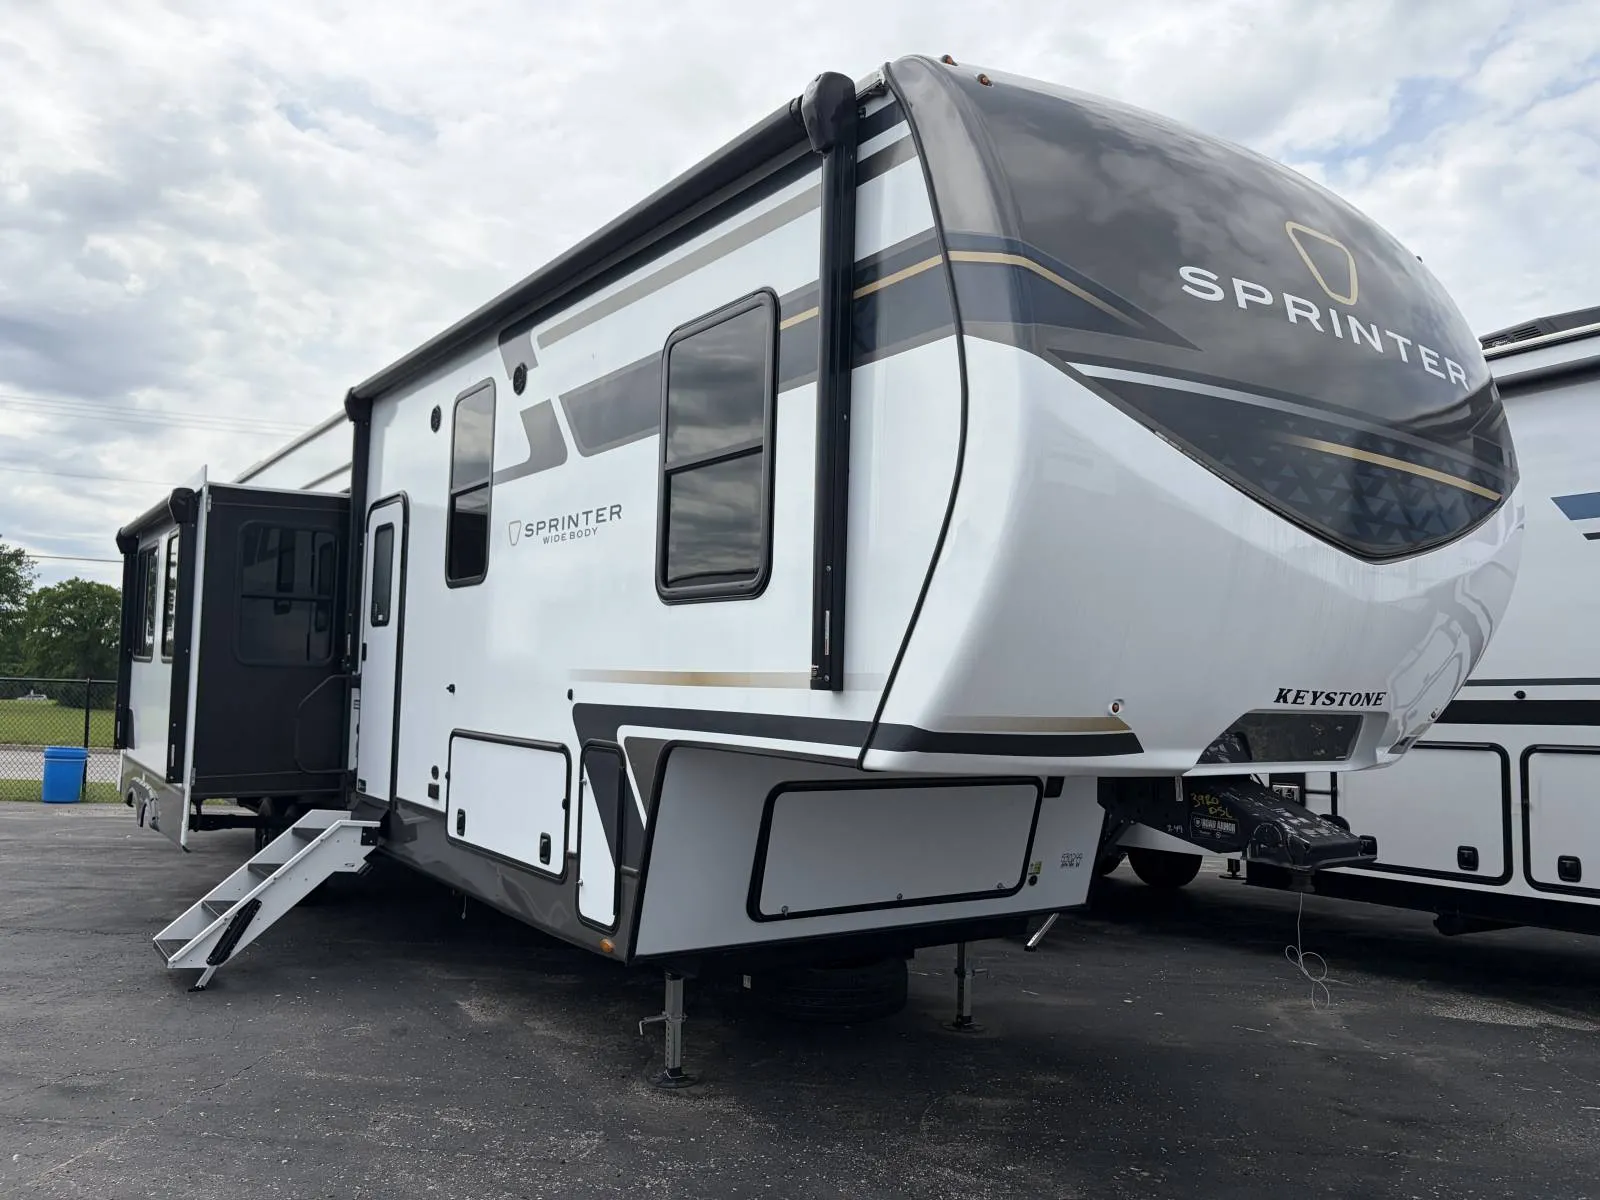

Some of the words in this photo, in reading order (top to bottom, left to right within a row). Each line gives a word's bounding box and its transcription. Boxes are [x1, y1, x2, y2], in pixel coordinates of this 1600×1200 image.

[1179, 265, 1470, 391] SPRINTER
[524, 504, 622, 538] SPRINTER
[543, 533, 567, 545] WIDE
[569, 527, 598, 540] BODY
[1273, 687, 1387, 707] KEYSTONE
